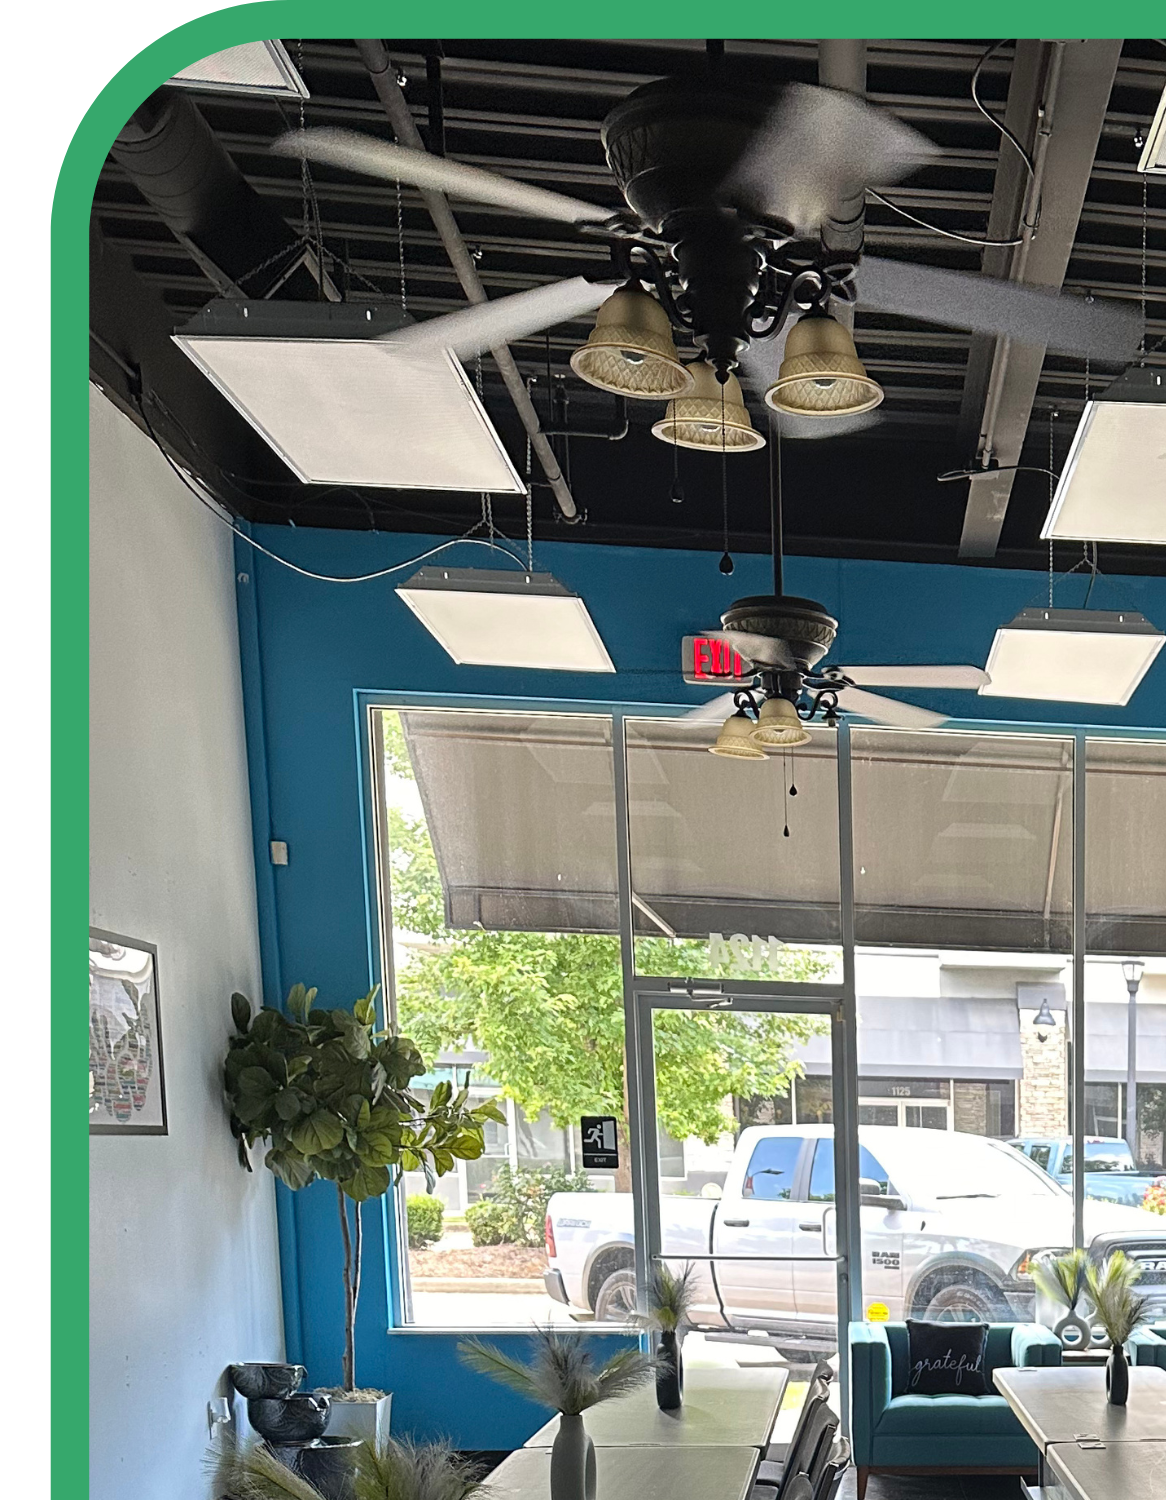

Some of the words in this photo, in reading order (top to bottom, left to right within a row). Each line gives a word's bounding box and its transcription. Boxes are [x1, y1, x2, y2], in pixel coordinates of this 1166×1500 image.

[891, 1086, 911, 1096] 1125
[872, 1258, 900, 1266] 1500
[910, 1348, 983, 1387] grateful
